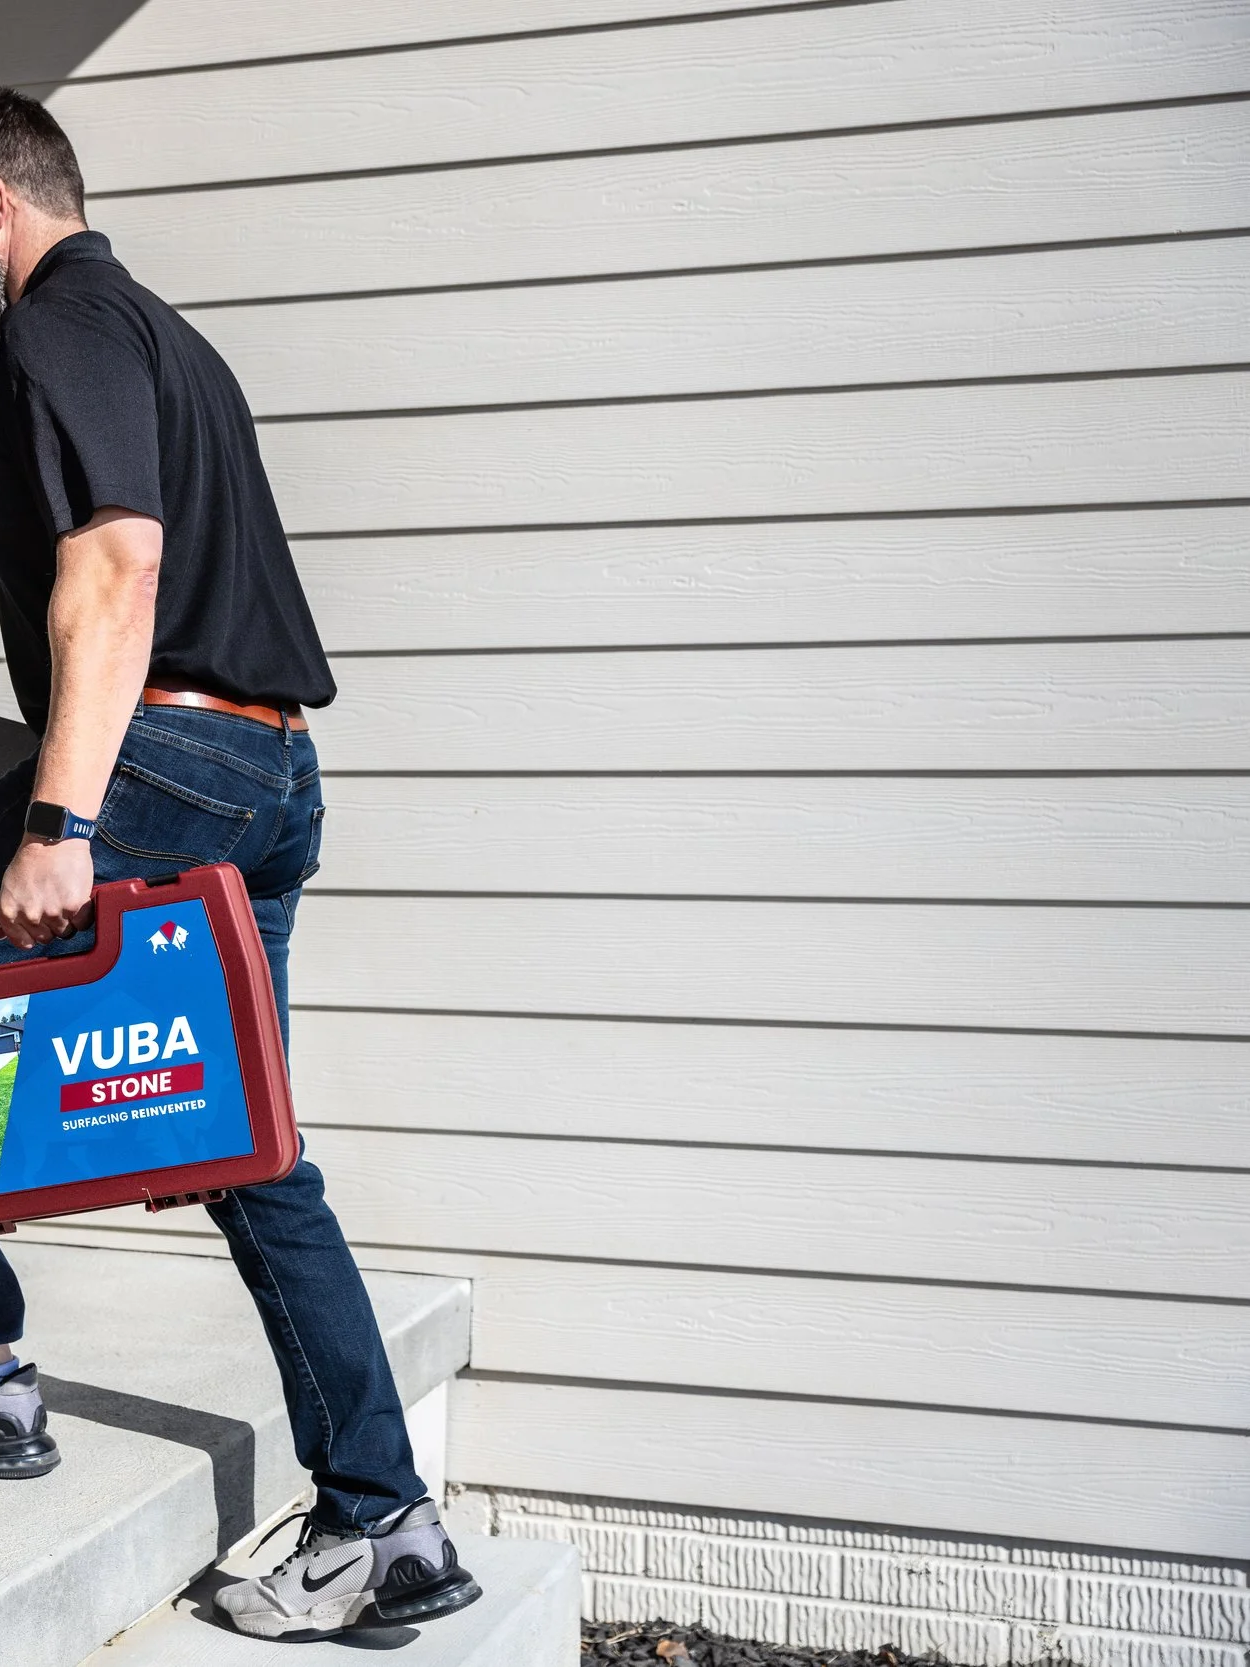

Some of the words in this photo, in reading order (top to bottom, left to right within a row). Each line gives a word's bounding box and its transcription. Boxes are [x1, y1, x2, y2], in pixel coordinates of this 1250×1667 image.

[52, 1016, 199, 1076] VUBA
[91, 1072, 172, 1103] STONE
[62, 1112, 129, 1131] SURFACING
[131, 1099, 206, 1120] REINVENTED
